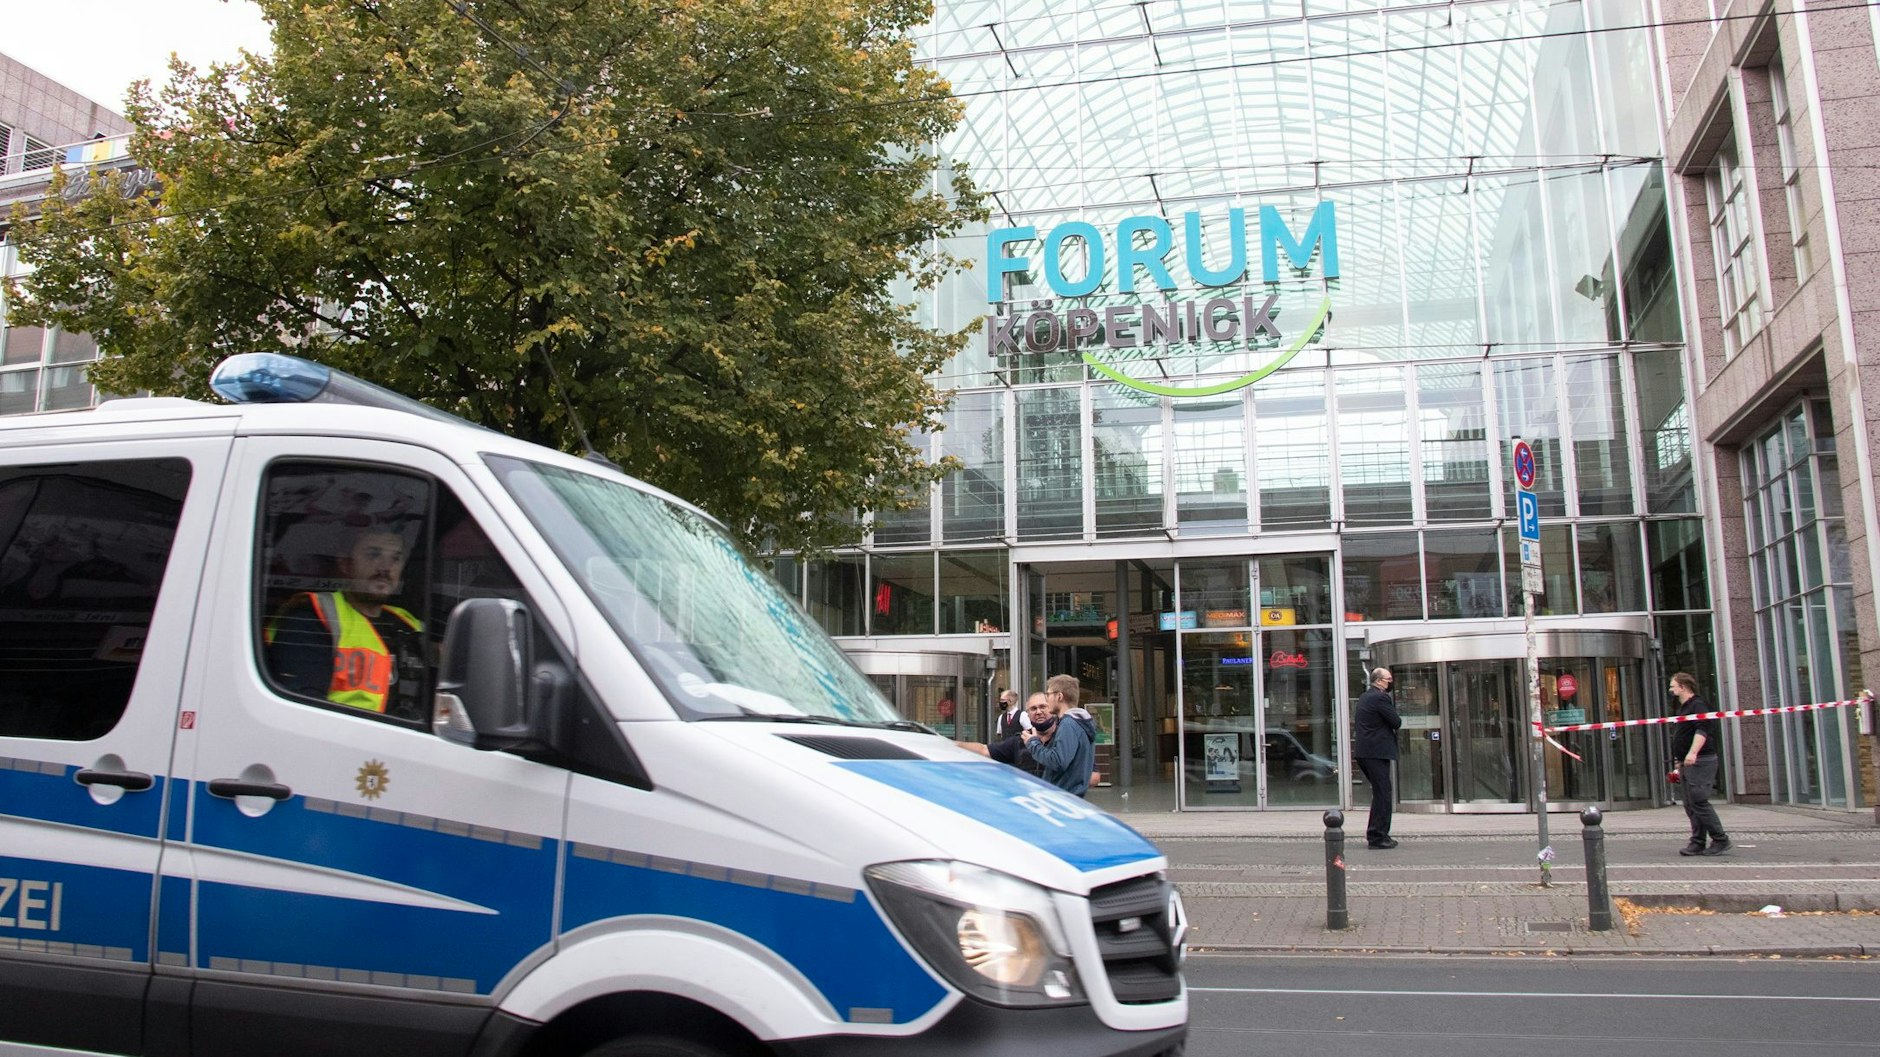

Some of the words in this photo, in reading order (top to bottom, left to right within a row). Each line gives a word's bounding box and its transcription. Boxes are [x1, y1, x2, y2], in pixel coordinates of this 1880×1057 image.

[987, 201, 1340, 304] FORUM
[987, 295, 1282, 357] KÖPENICK
[1522, 497, 1534, 533] P
